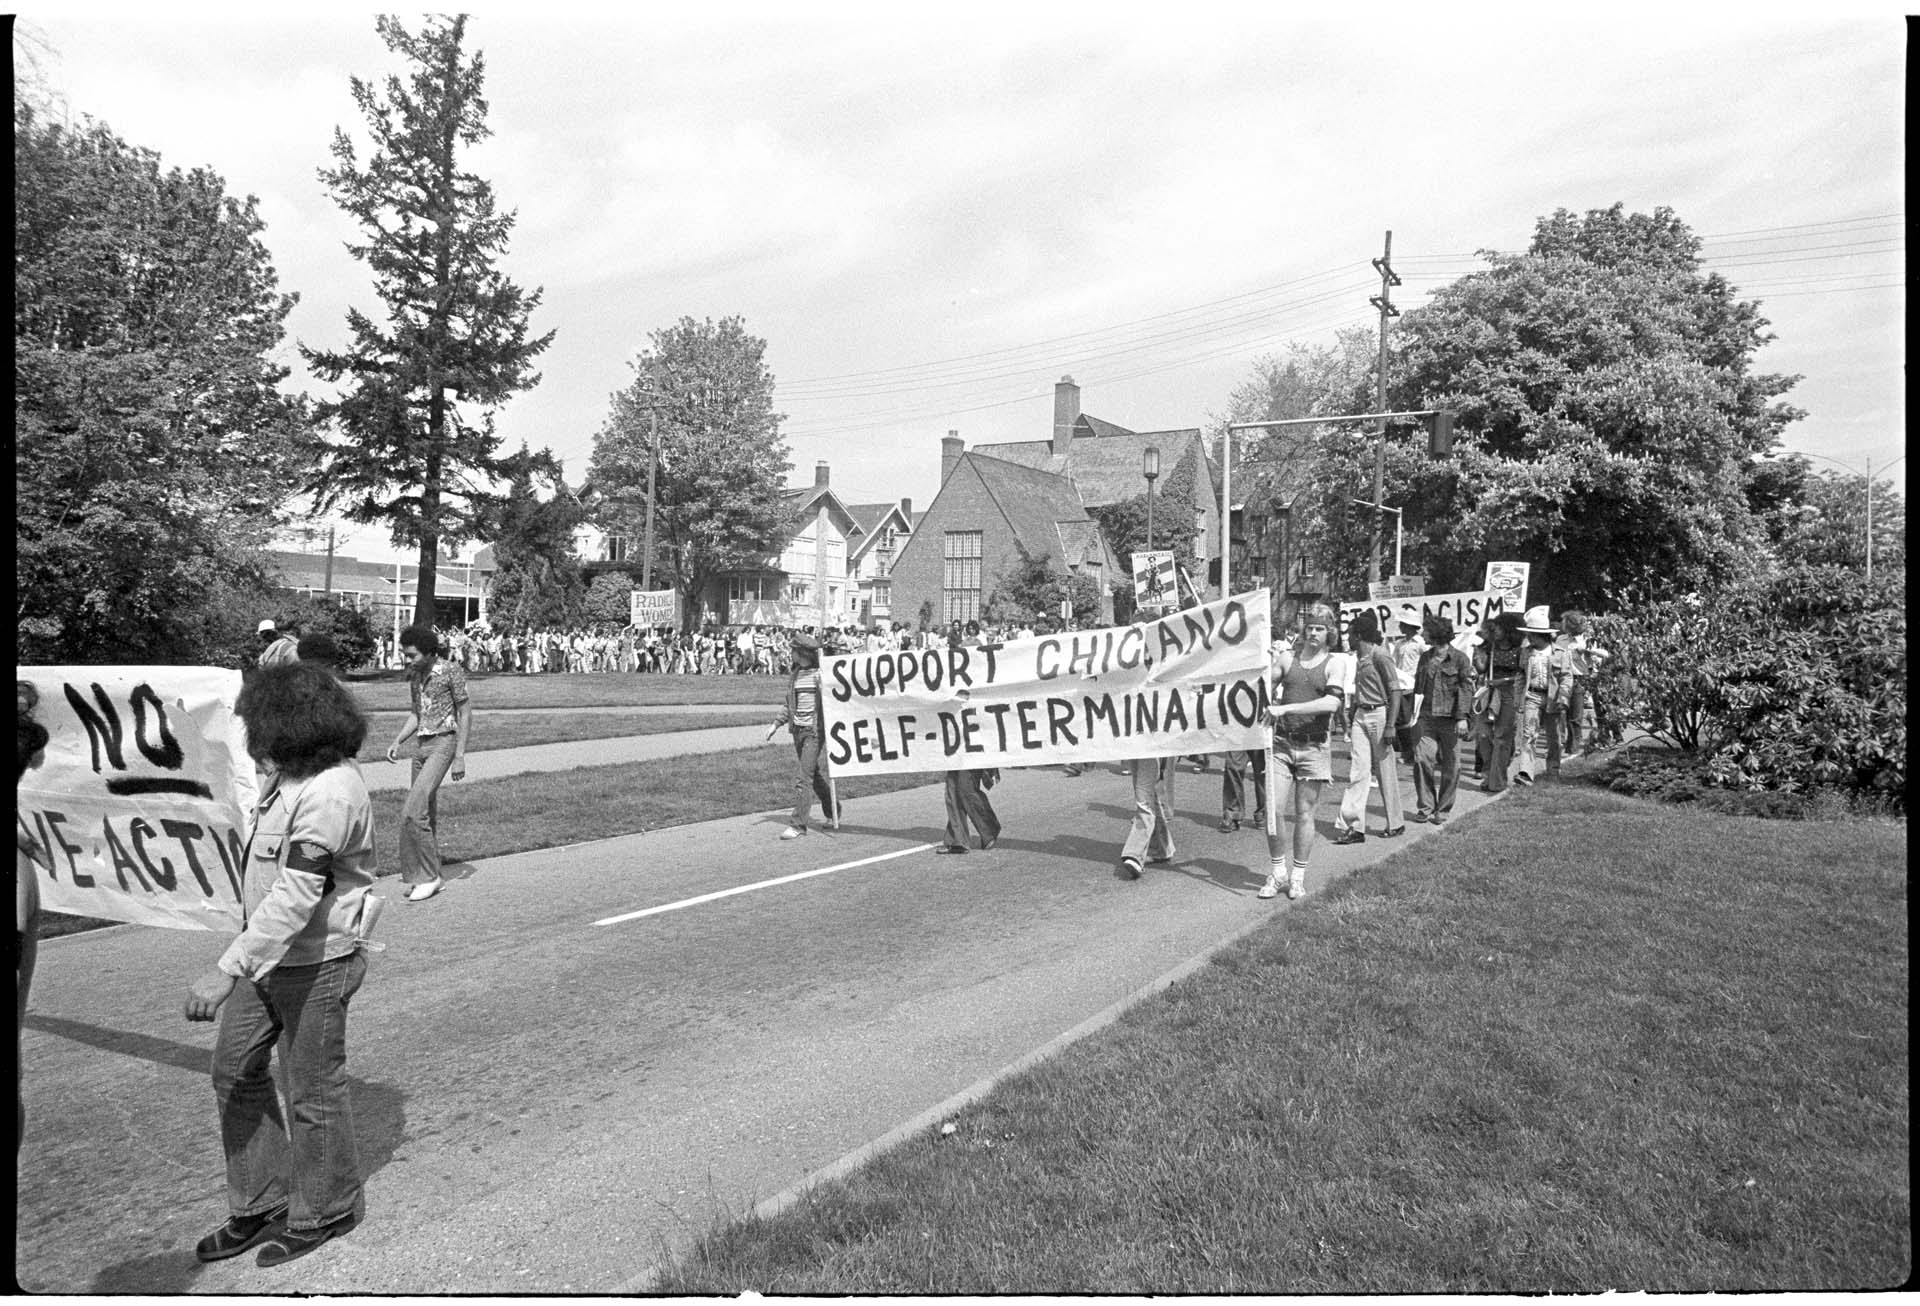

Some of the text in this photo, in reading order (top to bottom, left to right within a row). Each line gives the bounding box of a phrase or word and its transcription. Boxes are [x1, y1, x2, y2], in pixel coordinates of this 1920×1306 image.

[832, 601, 1247, 702] SUPPORT CHICANO
[1340, 596, 1503, 634] STP ACISM
[63, 682, 185, 775] NO
[829, 676, 1270, 766] SELF-DETERMINATION
